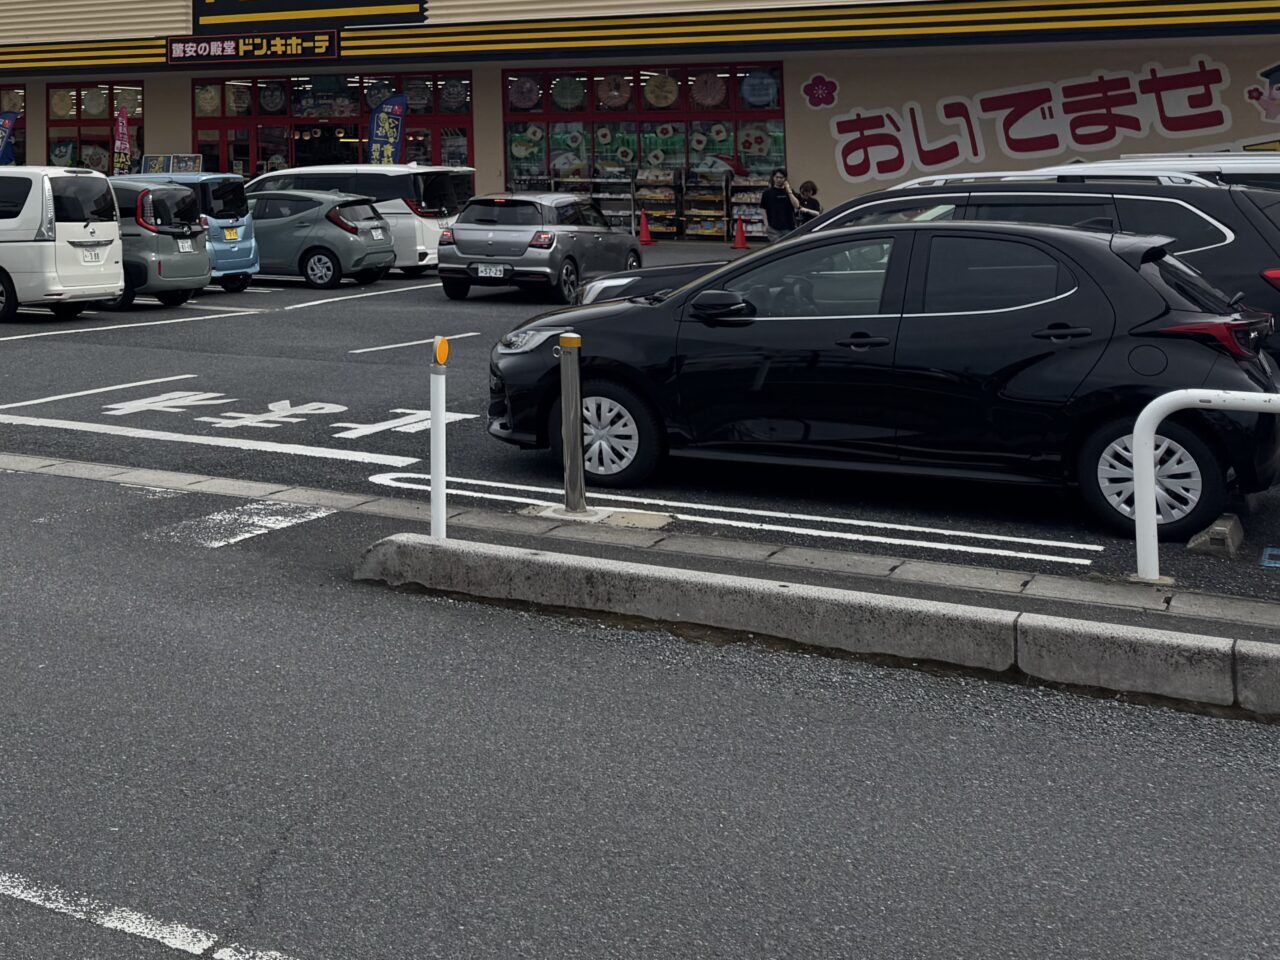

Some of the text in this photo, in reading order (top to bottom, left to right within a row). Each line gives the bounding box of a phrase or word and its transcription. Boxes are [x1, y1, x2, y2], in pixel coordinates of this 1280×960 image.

[835, 60, 1225, 177] おいでませ
[102, 390, 481, 439] とまれ
